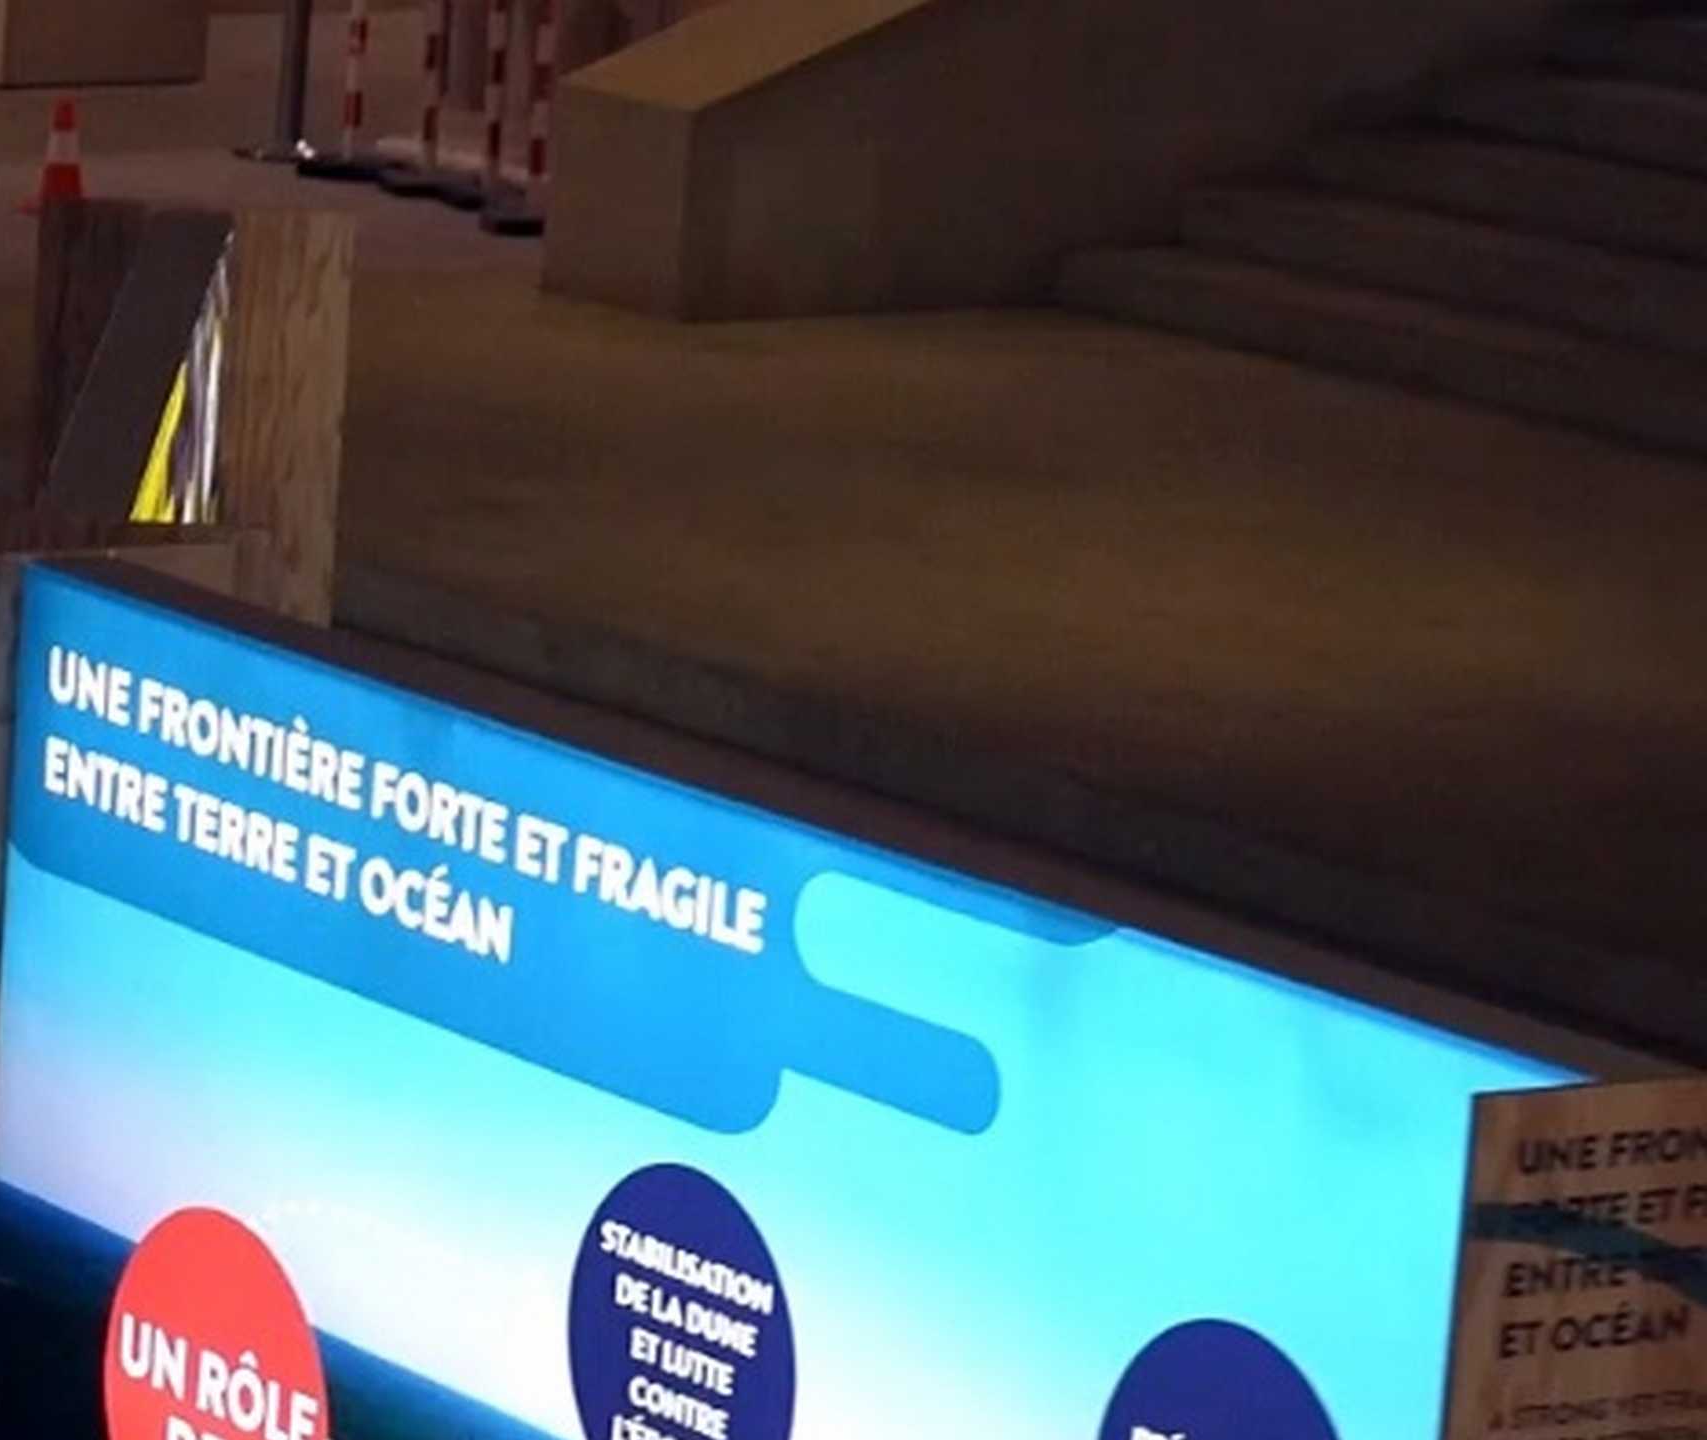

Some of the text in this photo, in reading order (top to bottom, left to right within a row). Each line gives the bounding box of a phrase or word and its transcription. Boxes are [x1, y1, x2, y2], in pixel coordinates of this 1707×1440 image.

[48, 645, 769, 955] UNE FRONTIÈRE FORTE ET FRAGILE
[44, 736, 514, 965] ENTRE TERRE ET OCÉAN
[1518, 1134, 1599, 1174] UNE
[600, 1219, 774, 1317] STABILISATION
[118, 1313, 188, 1402] UN
[614, 1272, 759, 1360] DE LA DUNE
[1499, 1300, 1691, 1359] ET OCÉAN
[629, 1328, 735, 1398] ET LUTTE
